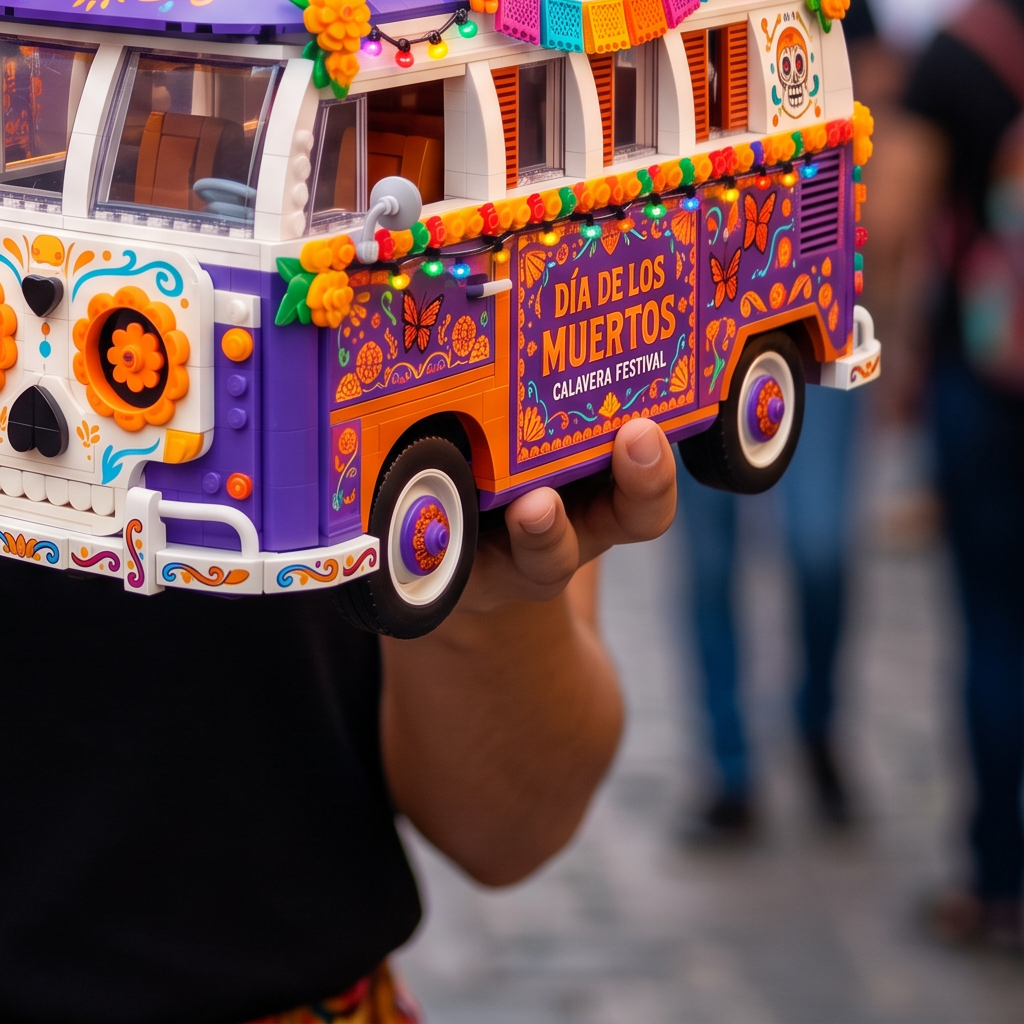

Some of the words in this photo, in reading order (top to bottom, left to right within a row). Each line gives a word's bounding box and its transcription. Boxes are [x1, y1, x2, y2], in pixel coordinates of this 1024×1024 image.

[554, 267, 592, 318] DÍA
[598, 266, 624, 306] DE
[628, 254, 666, 296] LOS
[542, 294, 677, 377] MUERTOS
[552, 367, 612, 401] CALAVERA
[615, 350, 667, 382] FESTIVAL
